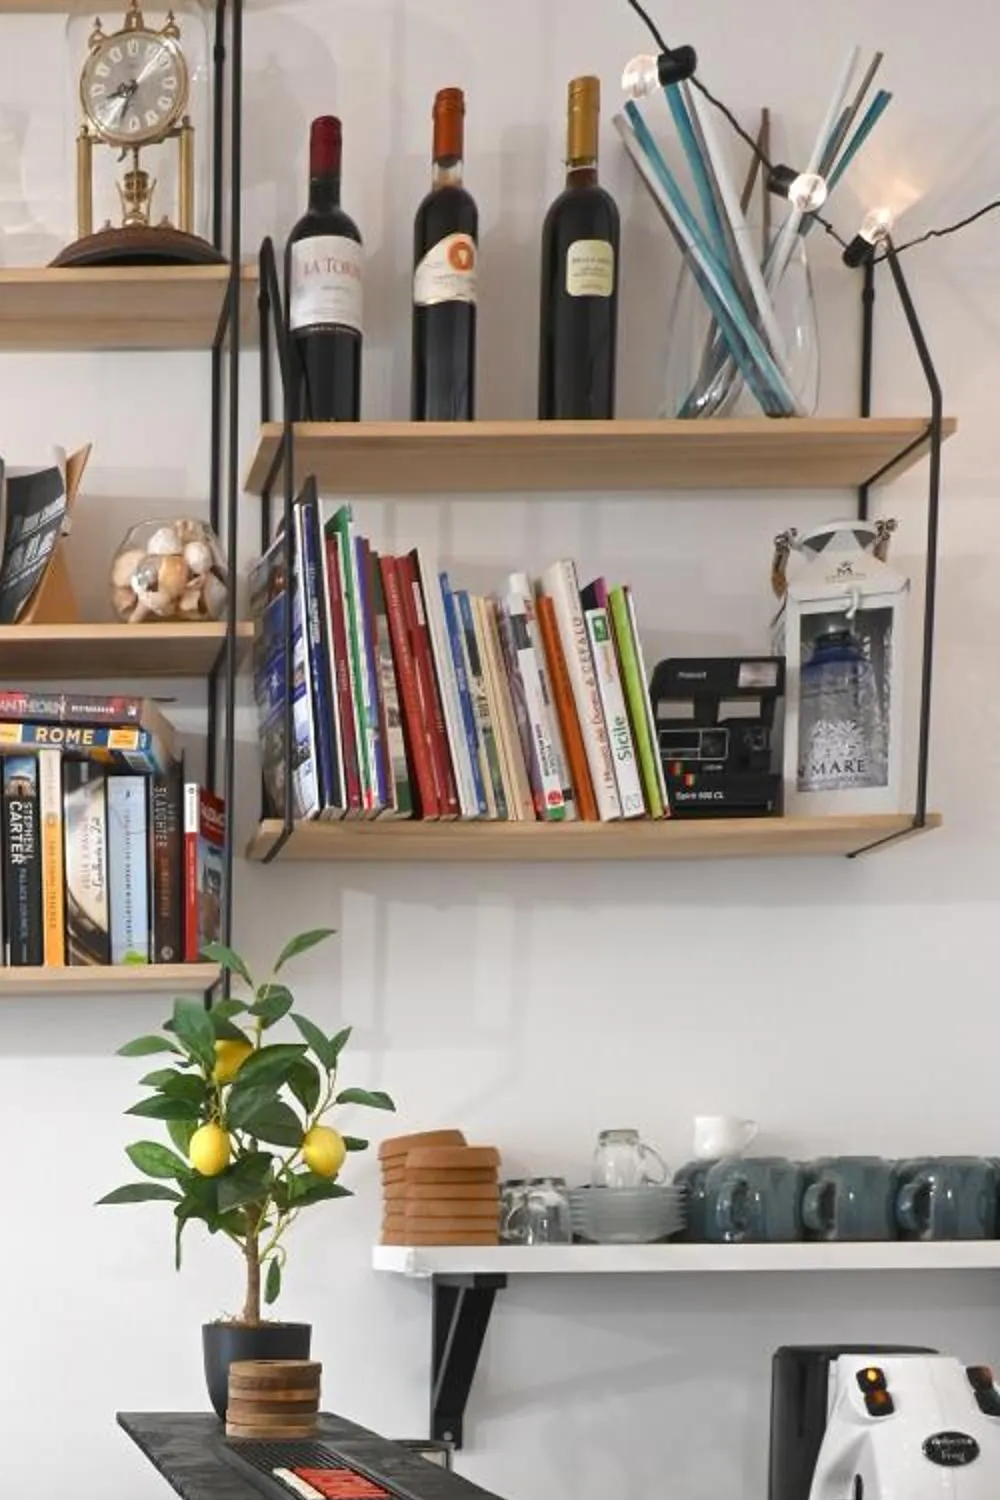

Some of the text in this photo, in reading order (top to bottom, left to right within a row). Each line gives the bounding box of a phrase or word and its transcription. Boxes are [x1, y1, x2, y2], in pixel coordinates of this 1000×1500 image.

[36, 727, 95, 745] ROME
[613, 716, 633, 764] Sicile
[811, 759, 866, 775] MARE
[9, 801, 23, 865] CARTER
[22, 801, 34, 852] STEPHEN
[154, 786, 167, 848] SLAUGHTER
